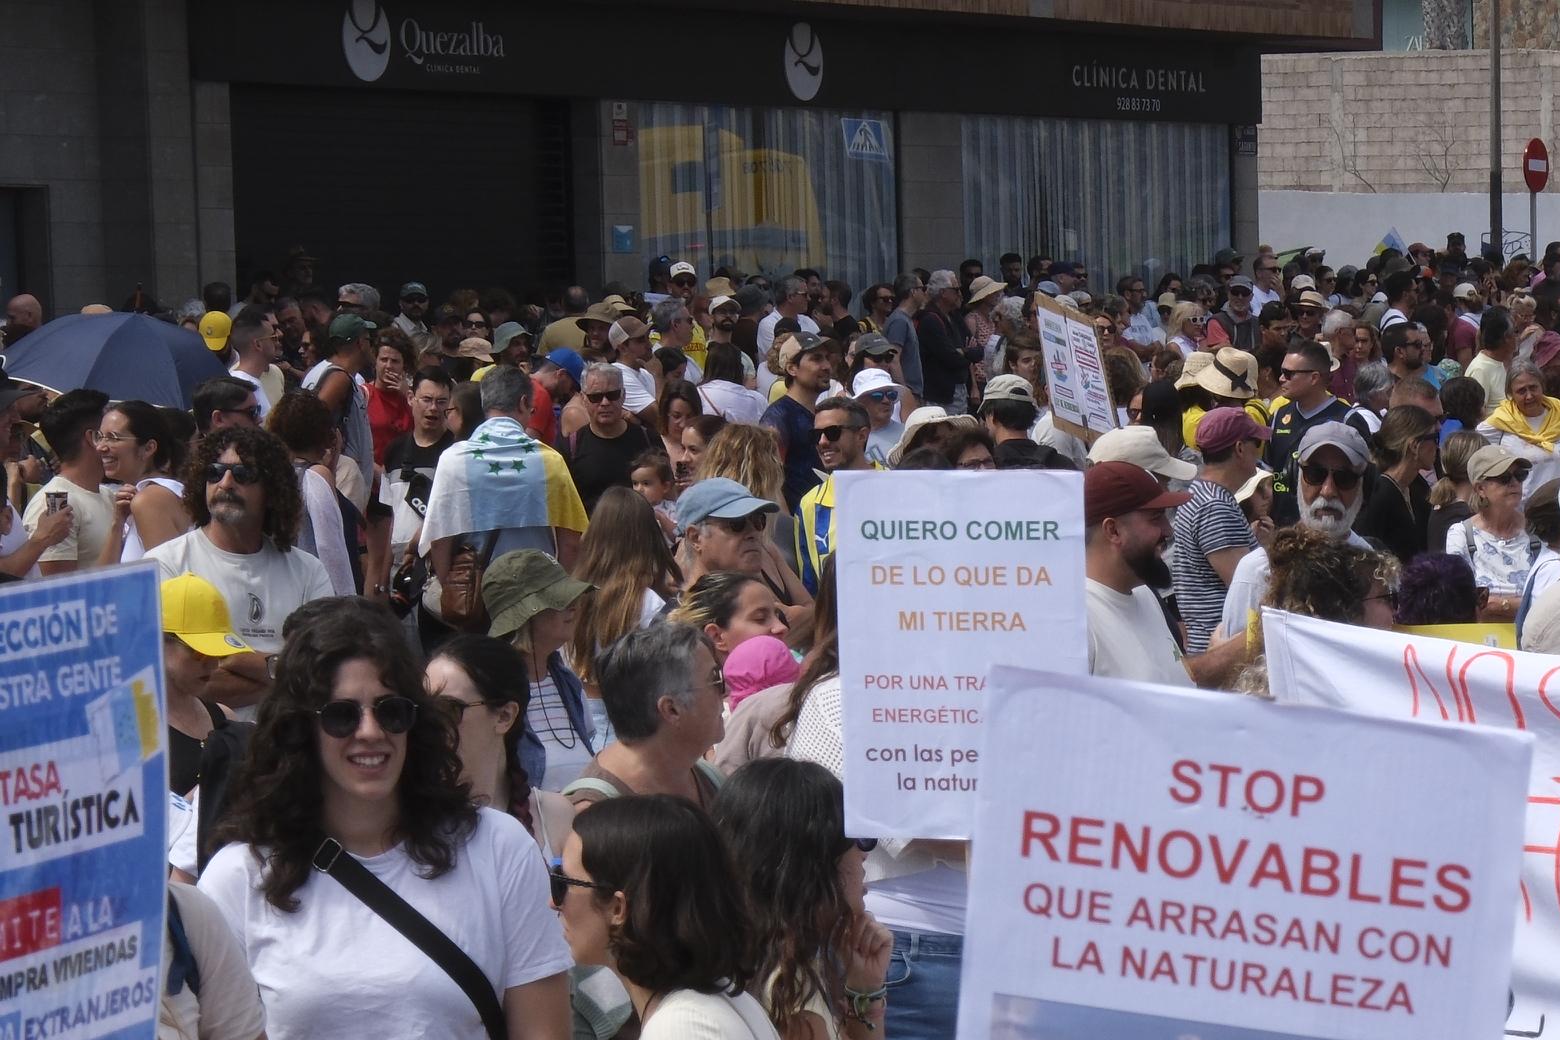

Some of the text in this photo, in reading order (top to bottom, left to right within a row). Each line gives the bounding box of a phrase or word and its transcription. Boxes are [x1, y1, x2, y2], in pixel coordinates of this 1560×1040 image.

[401, 18, 505, 64] Quezalba
[1072, 60, 1207, 93] CLÍNICA DENTAL
[861, 520, 1061, 542] QUIERO COMER
[871, 566, 1053, 587] DE LO QUE DA
[91, 603, 118, 638] DE
[899, 611, 1027, 632] MI TIERRA
[57, 656, 121, 697] GENTE
[864, 675, 903, 690] POR
[909, 676, 947, 691] UNA
[872, 706, 984, 725] ENERGÉTIC
[865, 747, 907, 762] con
[914, 744, 944, 763] las
[0, 760, 61, 806] TASA
[897, 773, 917, 791] la
[1169, 759, 1326, 818] STOP
[9, 787, 140, 853] TURÍSTICA
[1020, 810, 1474, 914] RENOVABLES
[1023, 882, 1454, 969] QUE ARRASAN CON
[53, 934, 138, 984] VIVIENDAS
[1050, 936, 1415, 1016] LA NATURALEZA
